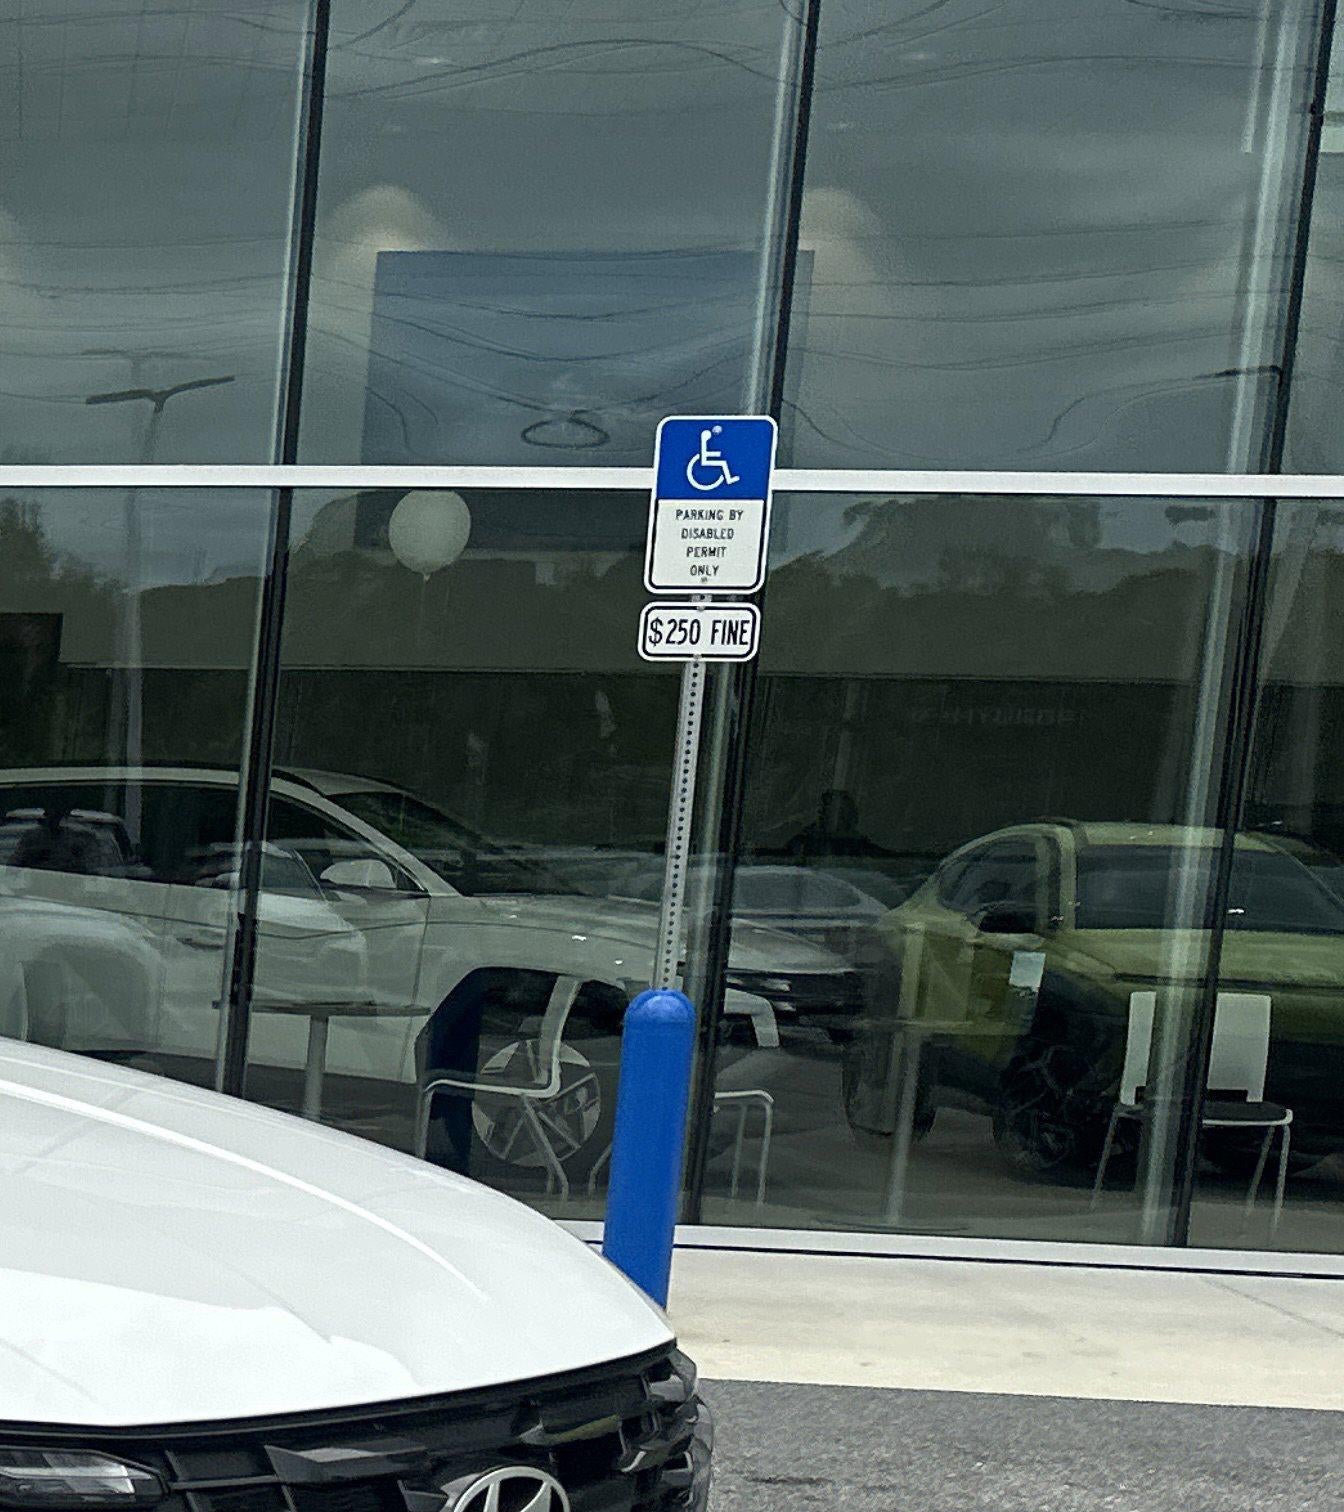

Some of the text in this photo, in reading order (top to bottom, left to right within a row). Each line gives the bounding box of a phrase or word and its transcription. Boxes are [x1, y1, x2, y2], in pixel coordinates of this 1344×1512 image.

[675, 509, 744, 521] PARKING BY
[681, 527, 734, 540] DISABLED
[686, 546, 727, 558] PERMIT
[690, 564, 720, 577] ONLY
[648, 617, 750, 647] $250 FINE
